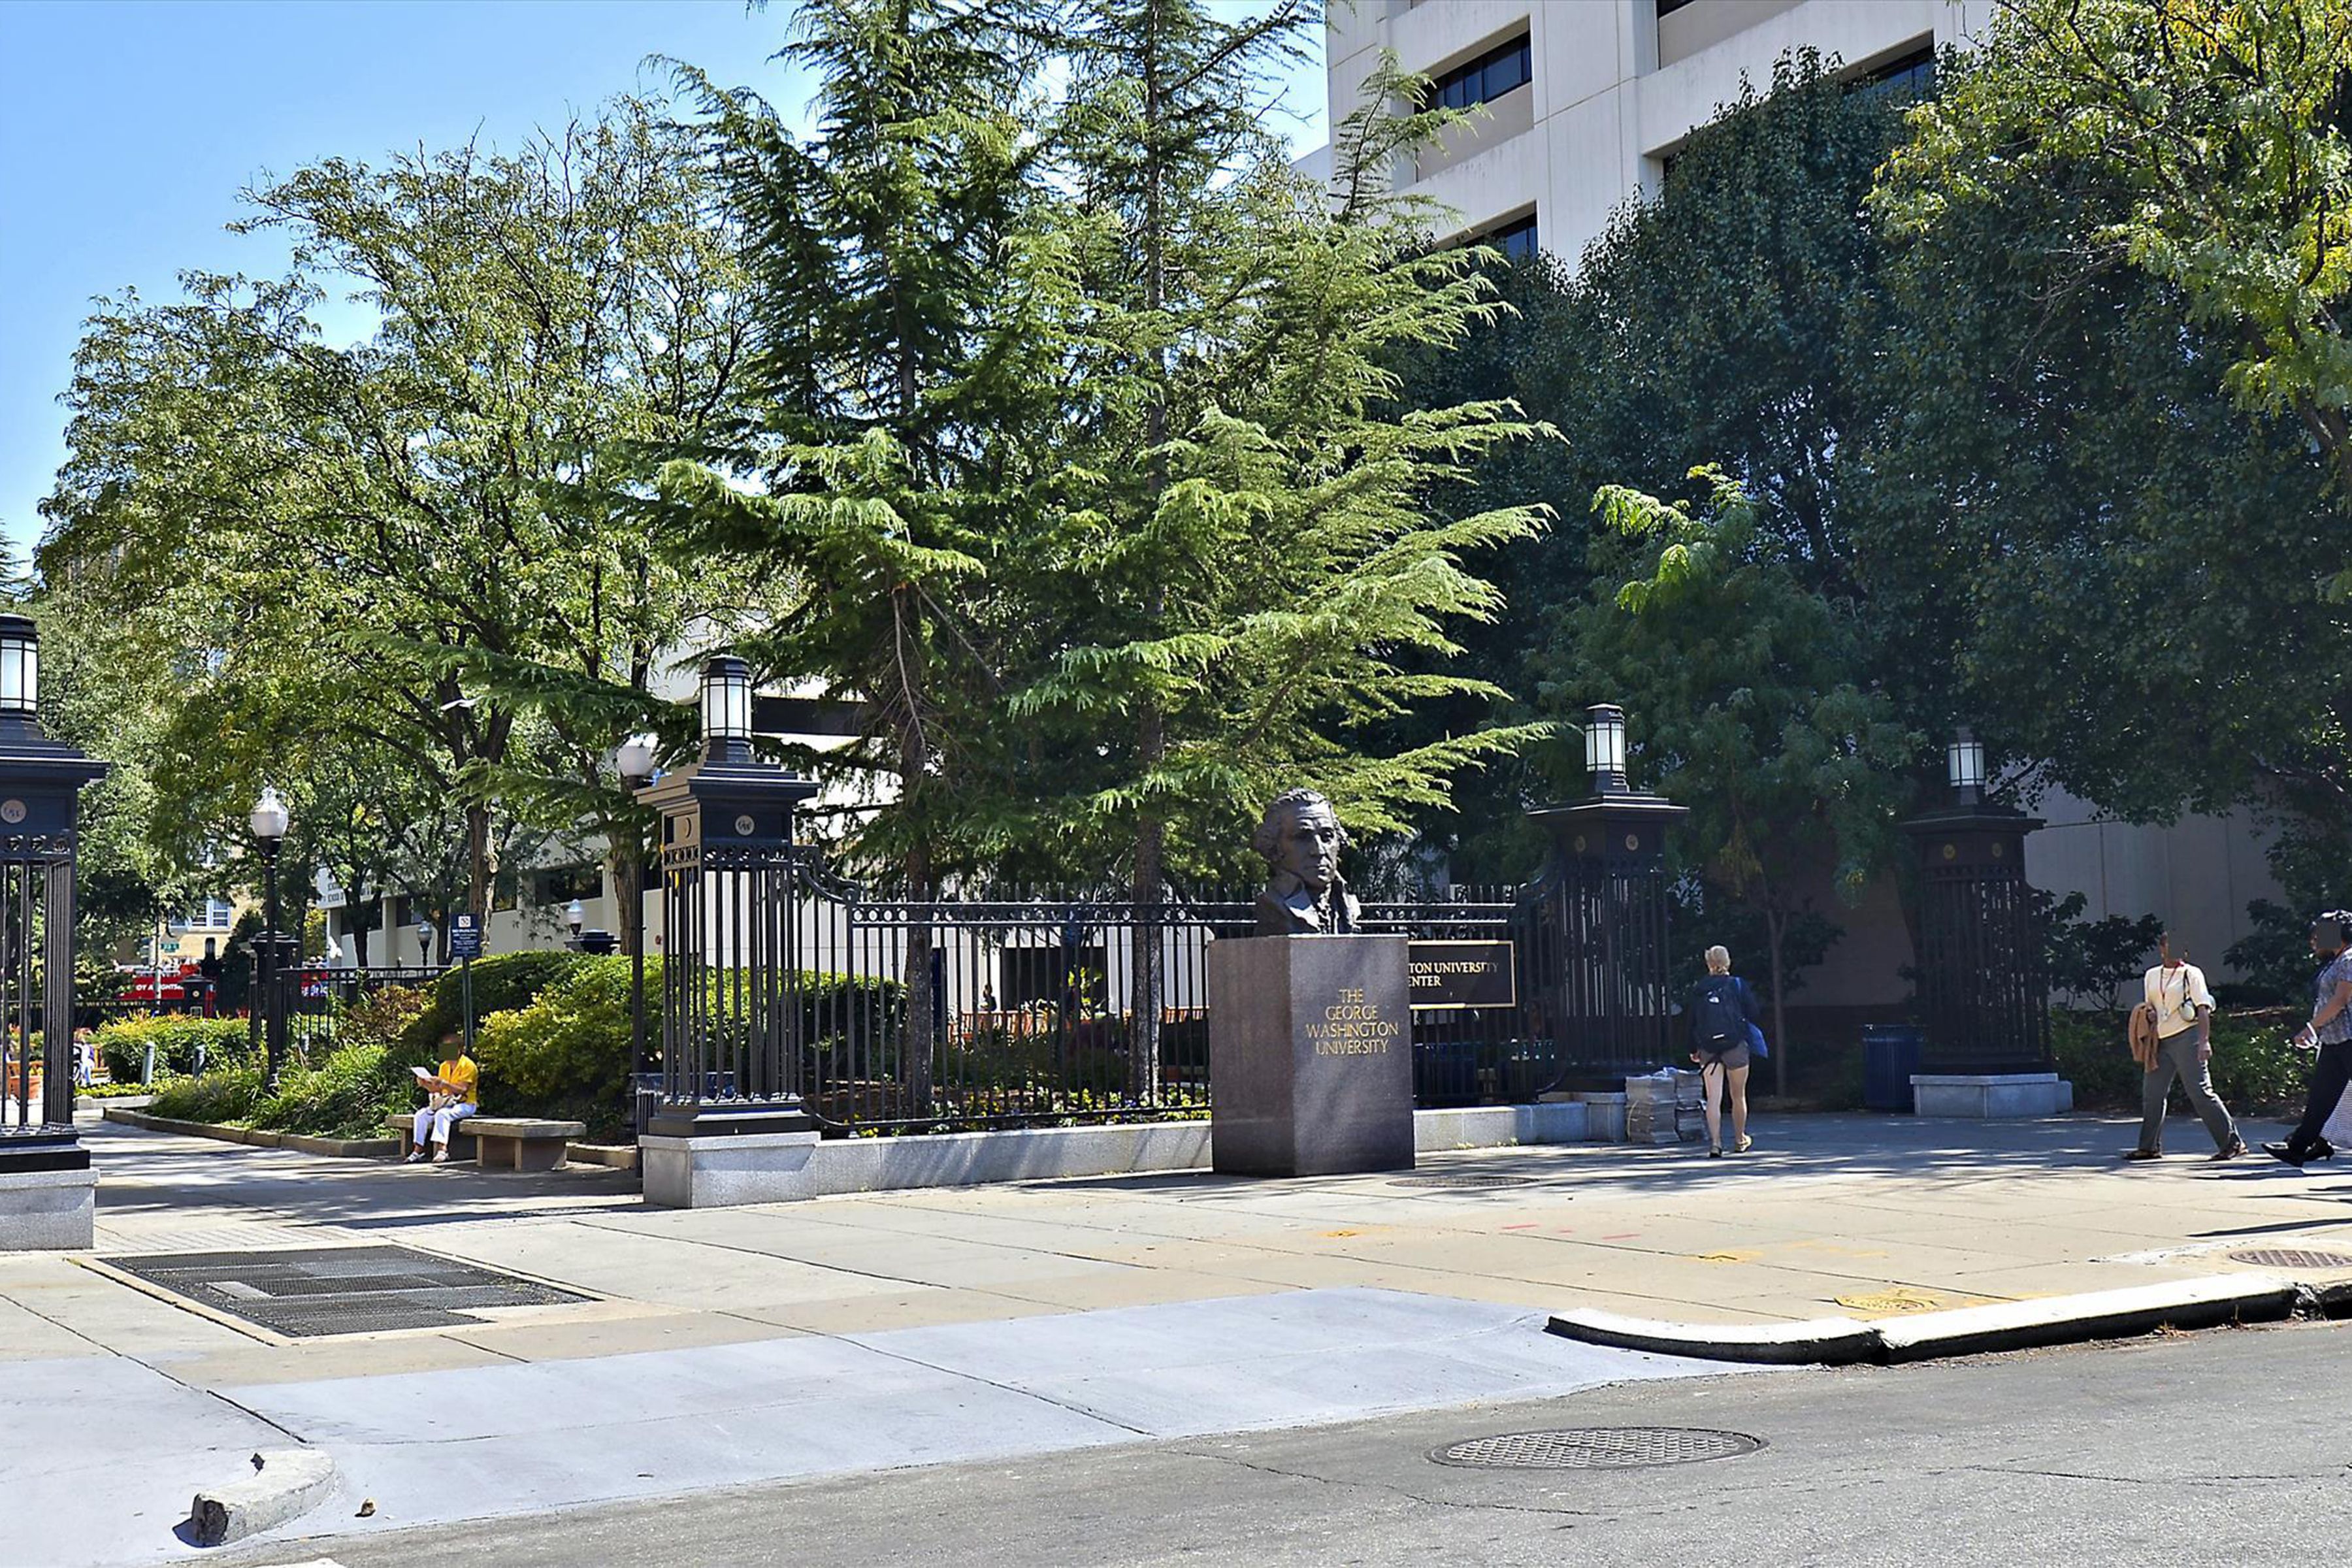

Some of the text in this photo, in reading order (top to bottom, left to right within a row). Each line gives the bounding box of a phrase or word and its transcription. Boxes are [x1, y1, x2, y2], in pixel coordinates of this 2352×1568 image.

[1433, 962, 1499, 974] UNIVERSITY
[1339, 988, 1364, 1003] THE
[1325, 1005, 1378, 1021] GEORGE
[1305, 1021, 1399, 1038] WASHINGTON
[1315, 1039, 1389, 1055] UNIVERSITY
